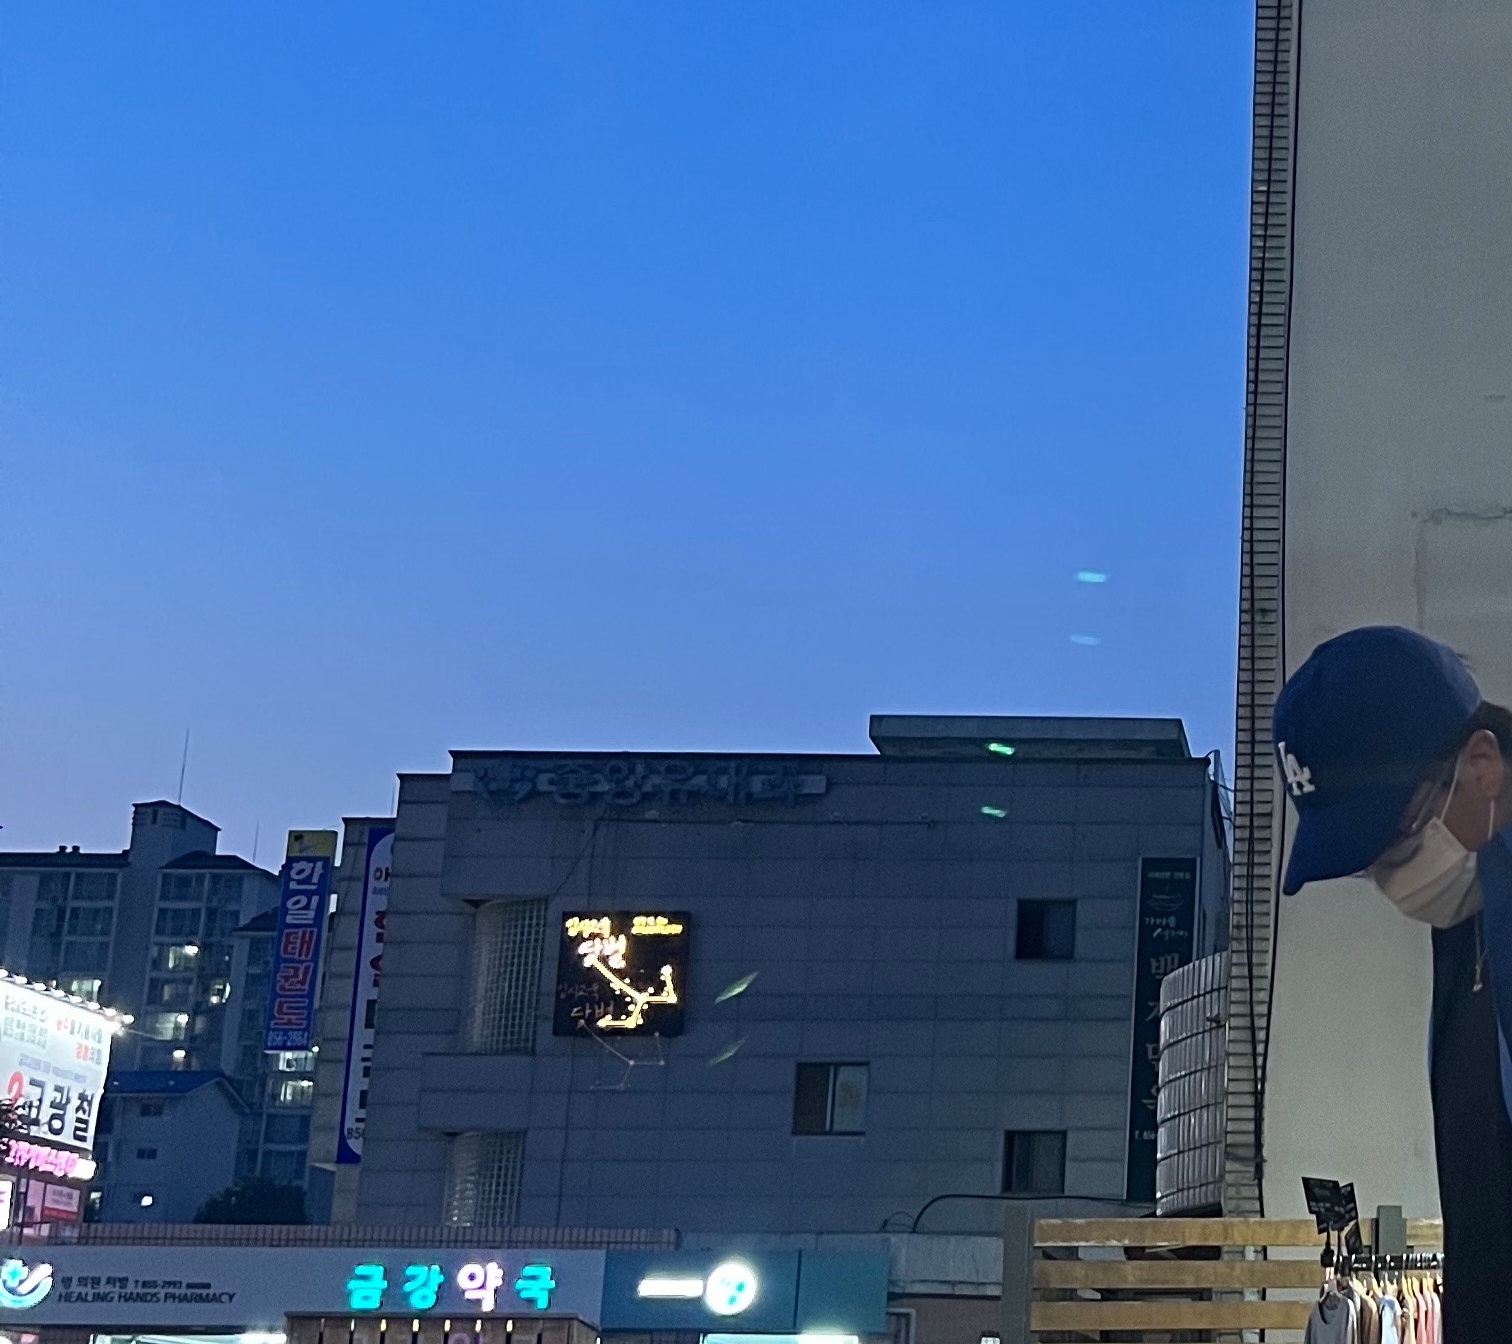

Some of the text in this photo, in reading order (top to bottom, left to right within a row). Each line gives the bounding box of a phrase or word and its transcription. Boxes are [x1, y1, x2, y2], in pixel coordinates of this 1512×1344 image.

[1278, 741, 1316, 796] LA
[58, 1290, 237, 1305] HEALING HANDS PHARMACY
[347, 1261, 557, 1312] 금강약국
